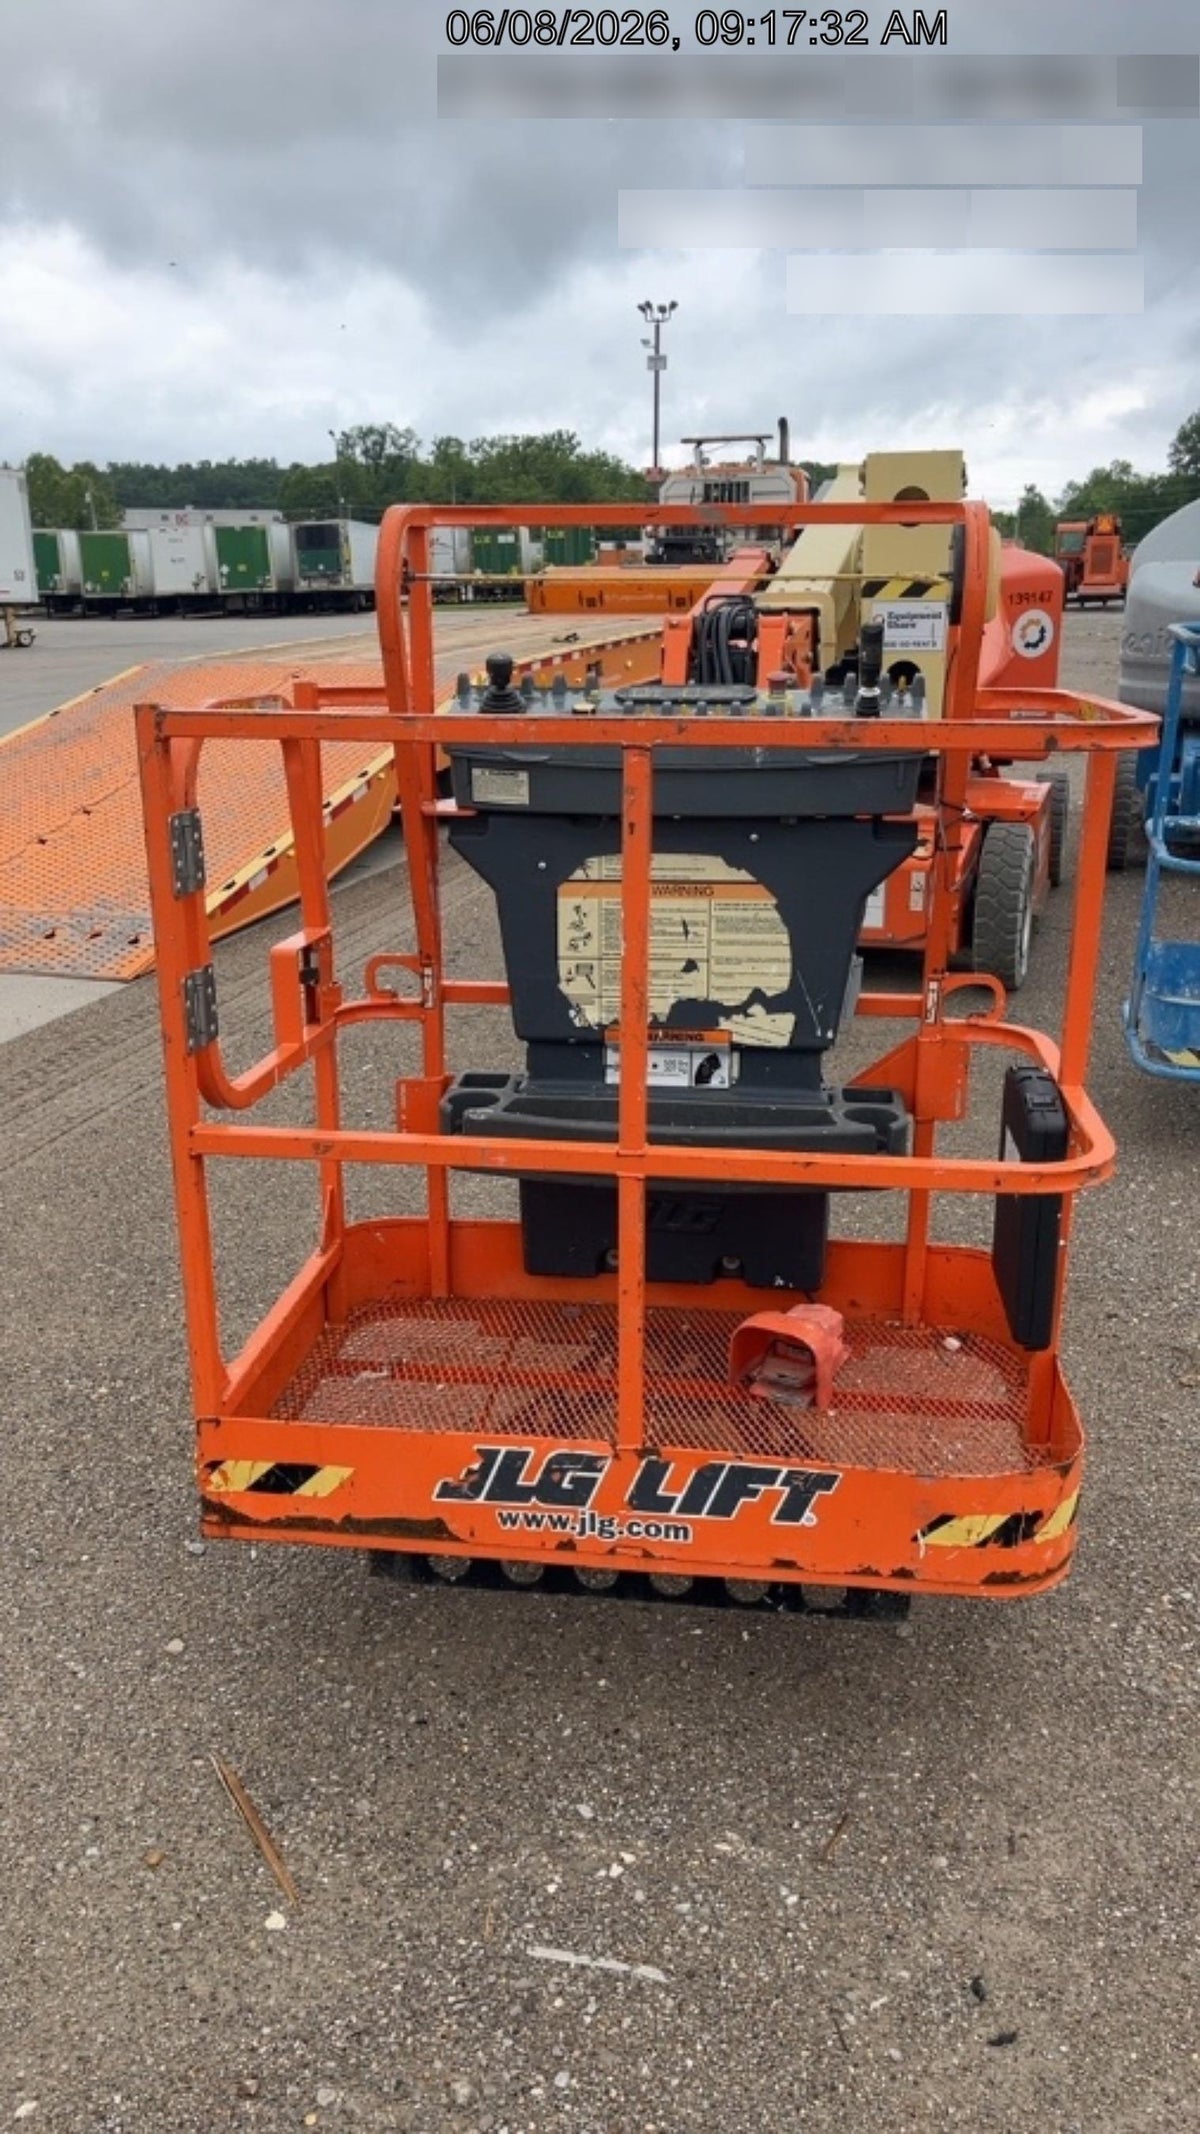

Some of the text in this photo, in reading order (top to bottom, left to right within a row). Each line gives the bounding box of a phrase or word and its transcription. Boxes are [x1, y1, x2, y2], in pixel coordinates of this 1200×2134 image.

[651, 884, 715, 897] WARNING
[433, 1444, 842, 1524] JLG LIFT
[497, 1508, 692, 1543] www.jlg.com
